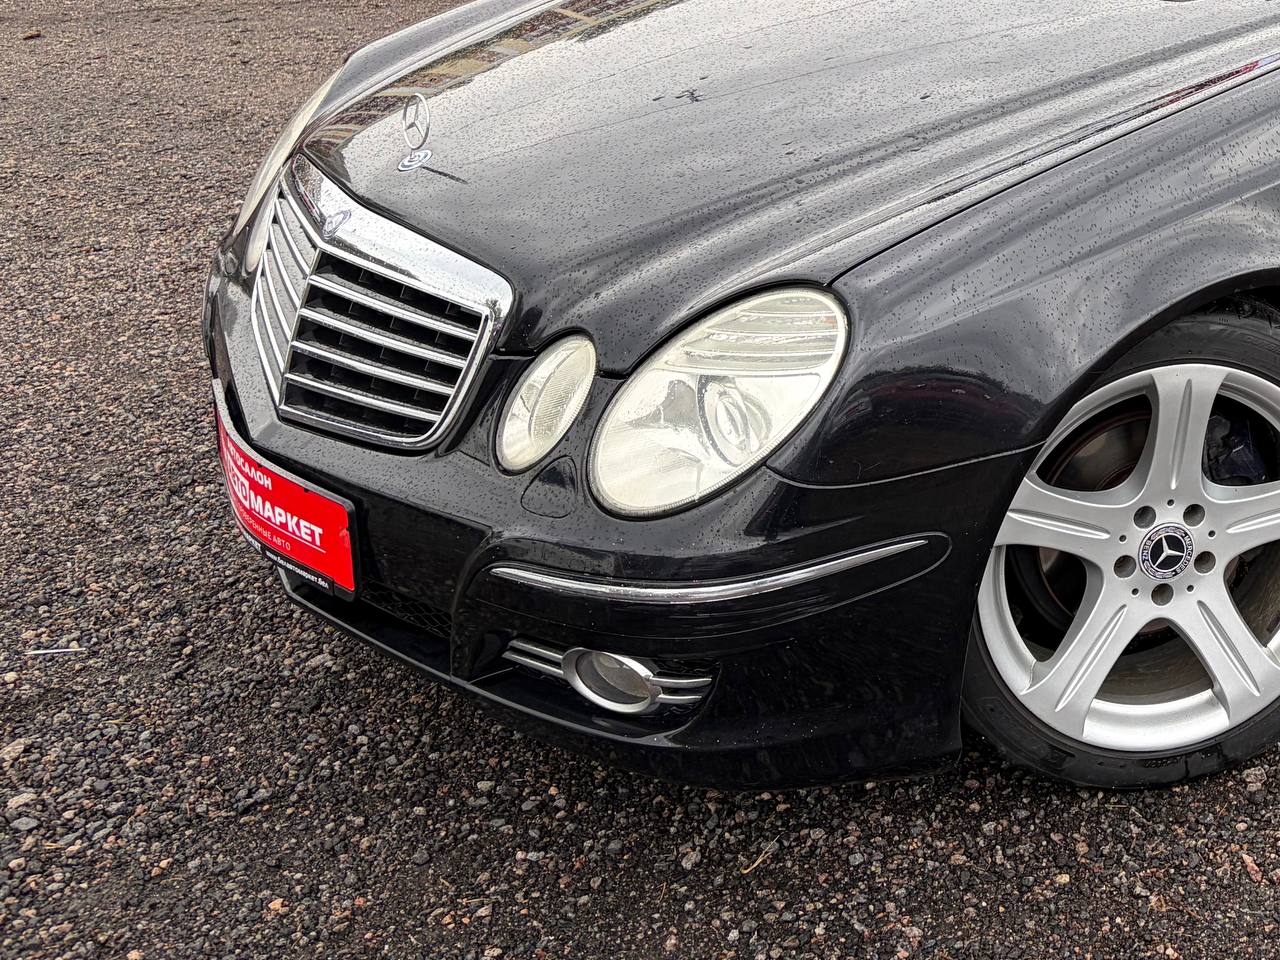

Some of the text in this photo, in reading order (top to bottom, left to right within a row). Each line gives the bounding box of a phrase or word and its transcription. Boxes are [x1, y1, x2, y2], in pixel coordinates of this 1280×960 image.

[249, 490, 323, 546] МАРКЕТ
[273, 535, 291, 551] АВТО
[1142, 540, 1152, 560] BENZ
[1176, 535, 1193, 573] MERCEDES
